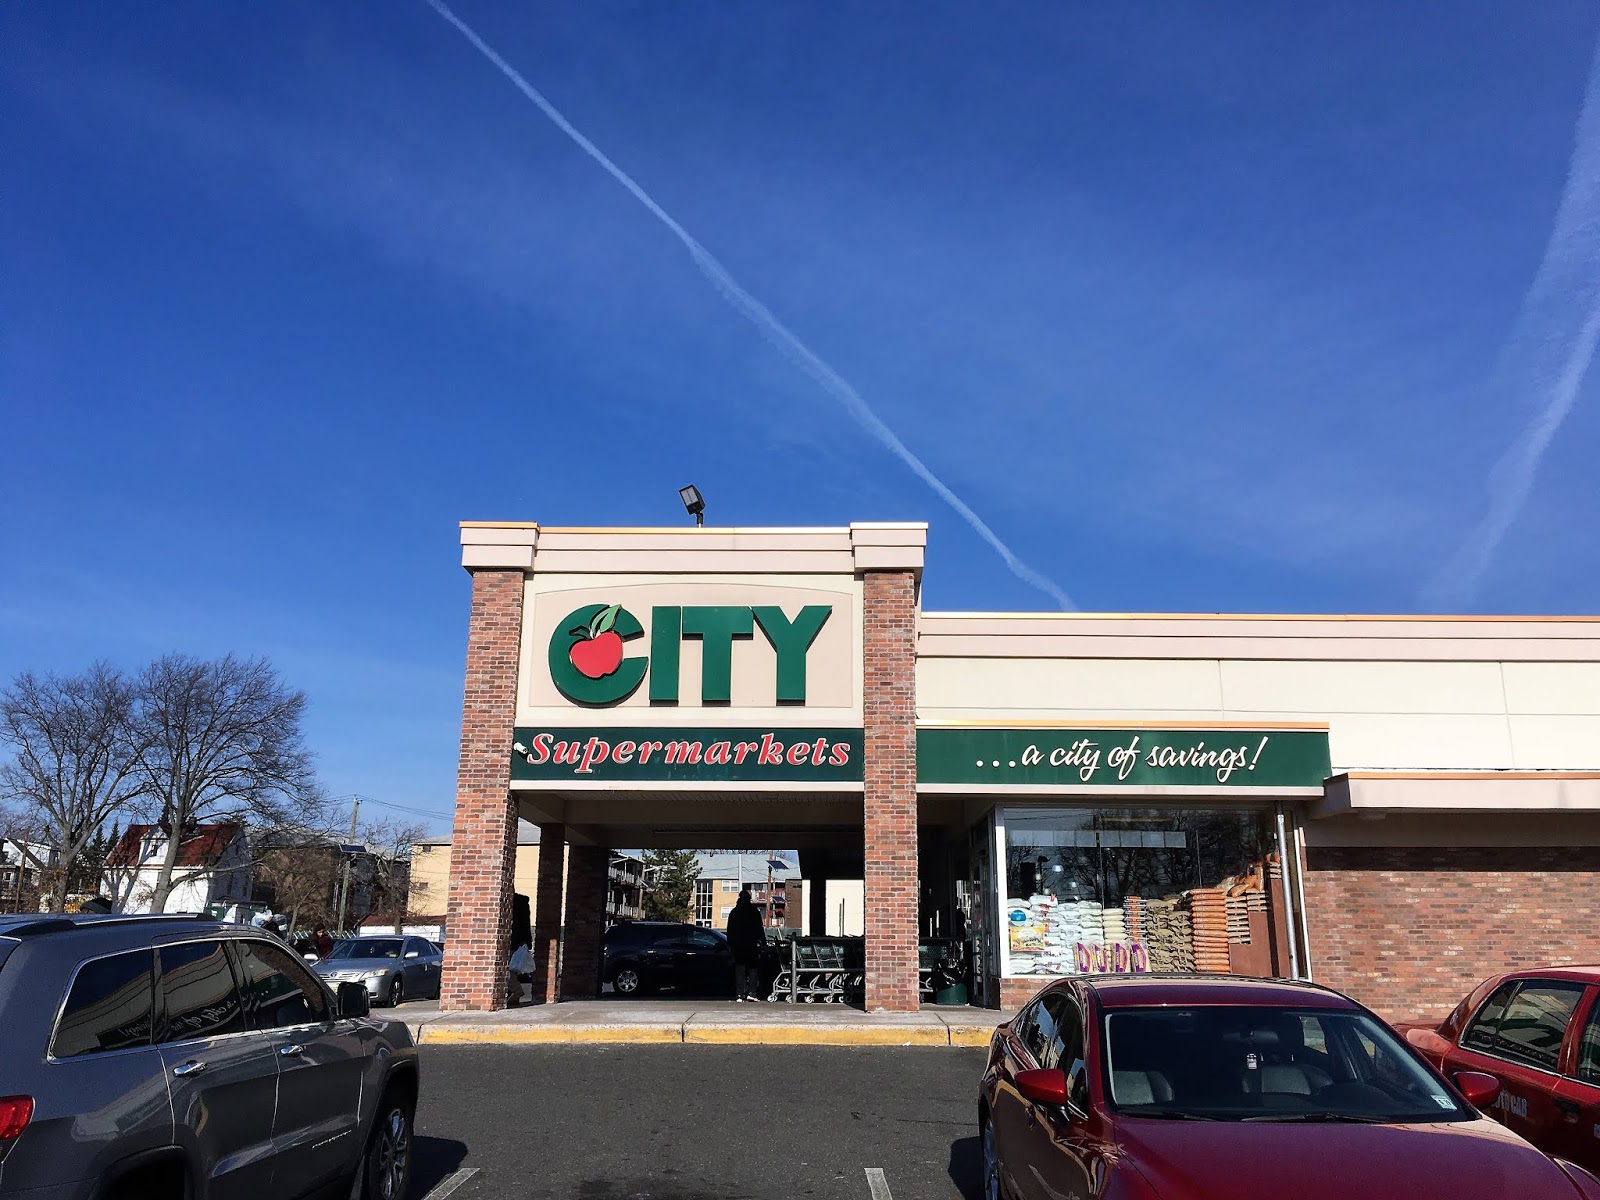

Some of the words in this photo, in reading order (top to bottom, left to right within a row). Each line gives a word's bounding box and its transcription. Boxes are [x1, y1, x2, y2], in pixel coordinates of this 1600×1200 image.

[548, 603, 832, 707] CITY
[527, 733, 851, 773] Supermarkets
[1050, 738, 1101, 781] city
[1107, 736, 1141, 780] of
[1145, 736, 1269, 782] savings!
